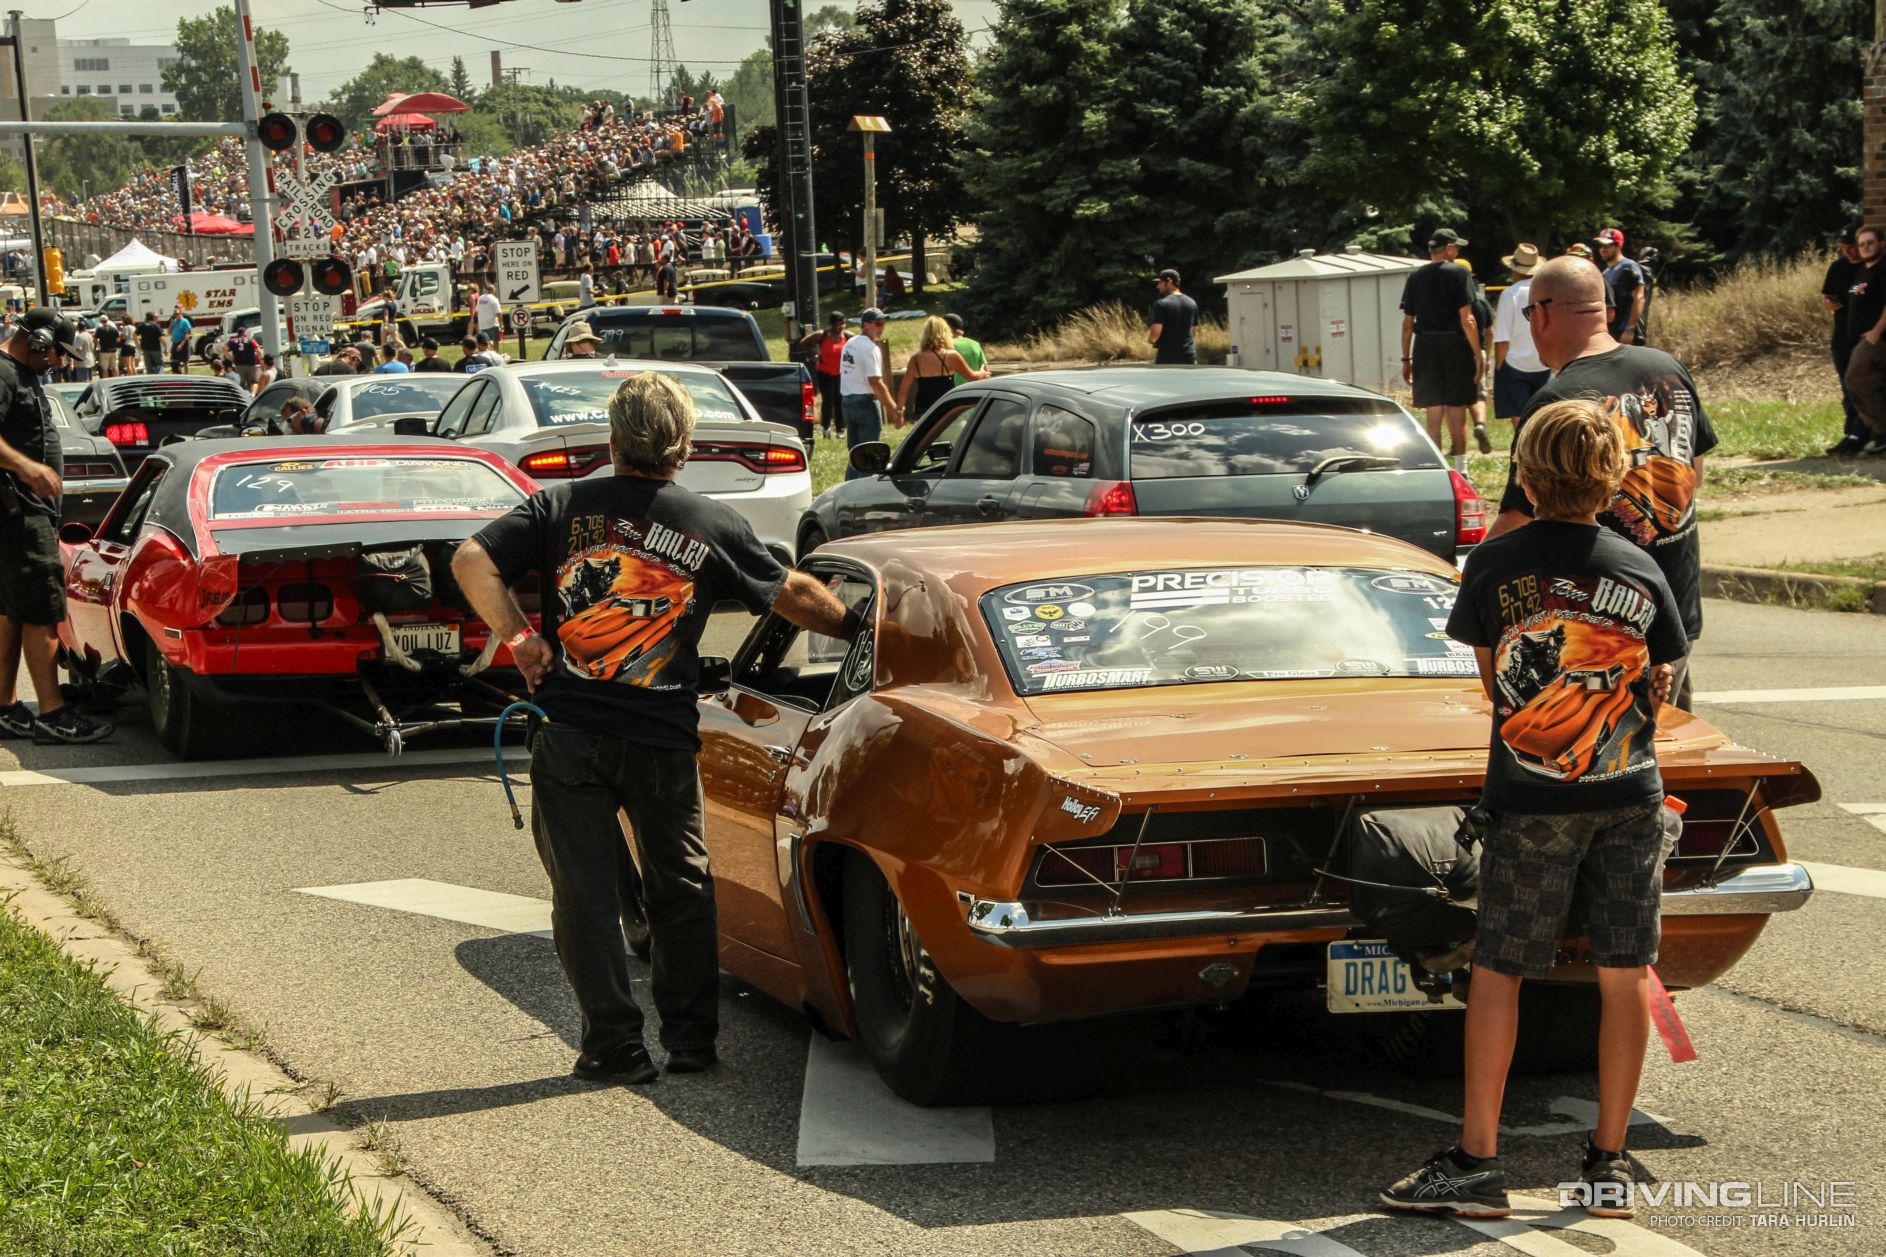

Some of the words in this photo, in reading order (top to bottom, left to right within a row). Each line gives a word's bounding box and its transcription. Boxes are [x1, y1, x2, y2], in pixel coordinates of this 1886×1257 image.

[278, 173, 333, 228] CROSSING
[303, 228, 311, 239] 2
[289, 243, 328, 251] TRACKS
[502, 247, 531, 258] STOP
[506, 271, 529, 281] RED
[204, 288, 237, 299] STAR
[208, 299, 234, 309] EMS
[294, 302, 330, 312] STOP
[313, 314, 331, 322] RED
[295, 325, 331, 333] SIGNAL
[1132, 422, 1205, 443] X300
[396, 460, 469, 468] DIAMOND
[236, 474, 294, 494] 129
[571, 515, 604, 535] 6.709
[643, 521, 709, 572] BAILEY
[1132, 571, 1332, 593] PRECISION
[1232, 586, 1333, 595] TURBO
[1232, 595, 1333, 604] BOOSTED
[394, 634, 417, 652] YOU
[1032, 667, 1152, 688] TURBOSMART
[1345, 959, 1407, 996] DRAG
